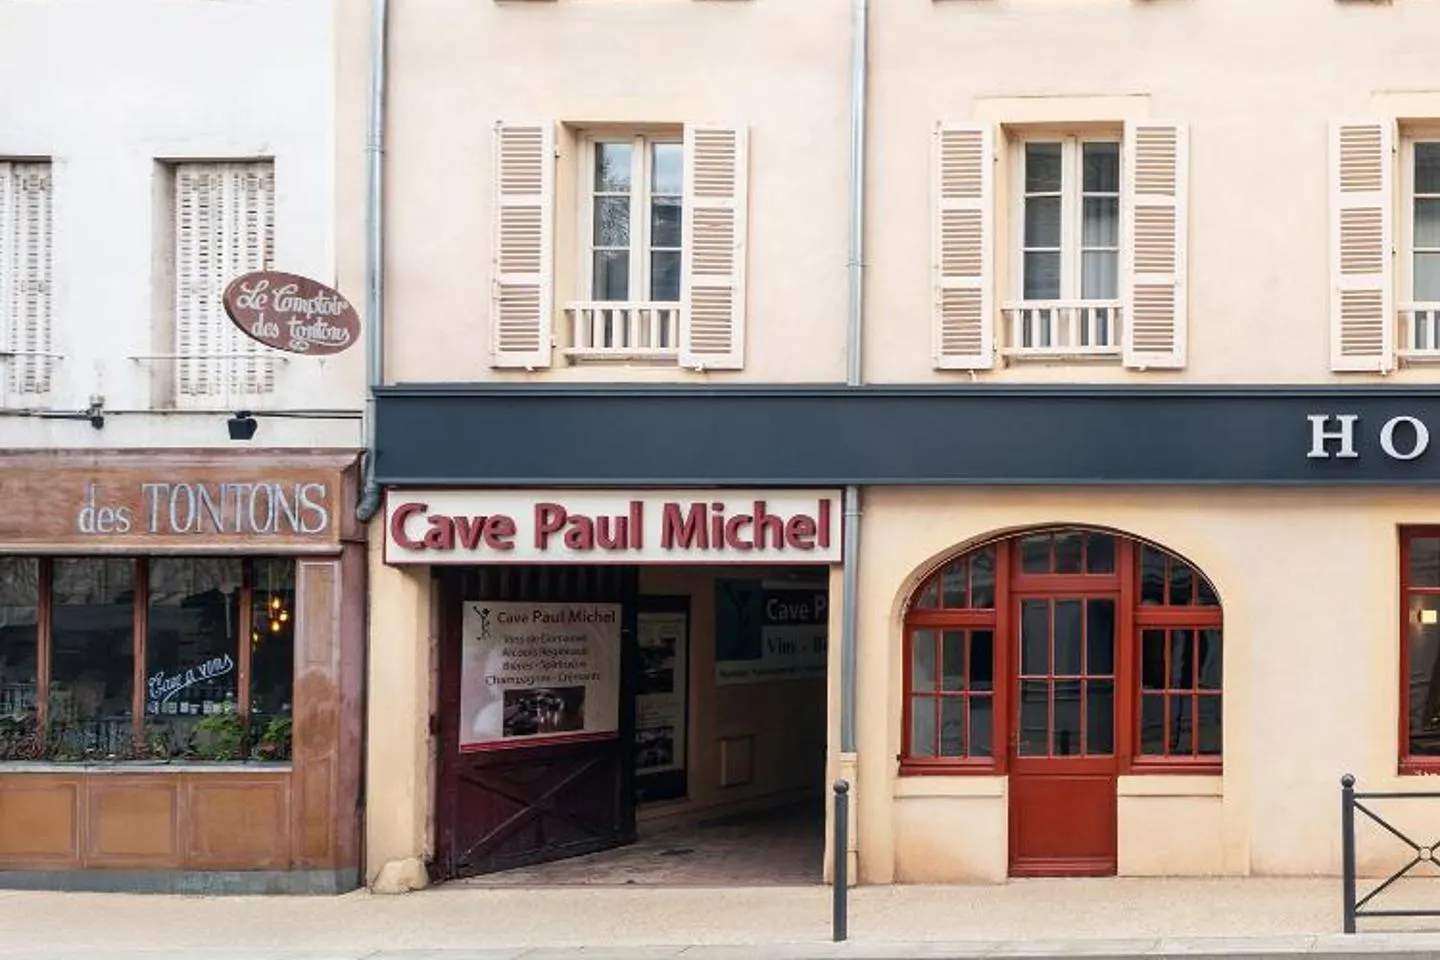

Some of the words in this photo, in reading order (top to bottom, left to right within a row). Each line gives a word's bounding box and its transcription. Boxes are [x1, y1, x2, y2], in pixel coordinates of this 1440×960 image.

[236, 280, 269, 310] Le
[272, 284, 349, 320] Comptoir
[251, 313, 279, 338] des
[78, 483, 132, 534] des
[142, 482, 329, 534] TONTONS
[390, 502, 517, 552] Cave
[534, 500, 644, 551] Paul
[661, 499, 832, 550] Michel
[497, 611, 529, 624] Cave
[533, 610, 566, 625] Paul
[569, 610, 616, 624] Michel
[766, 597, 810, 621] Cave
